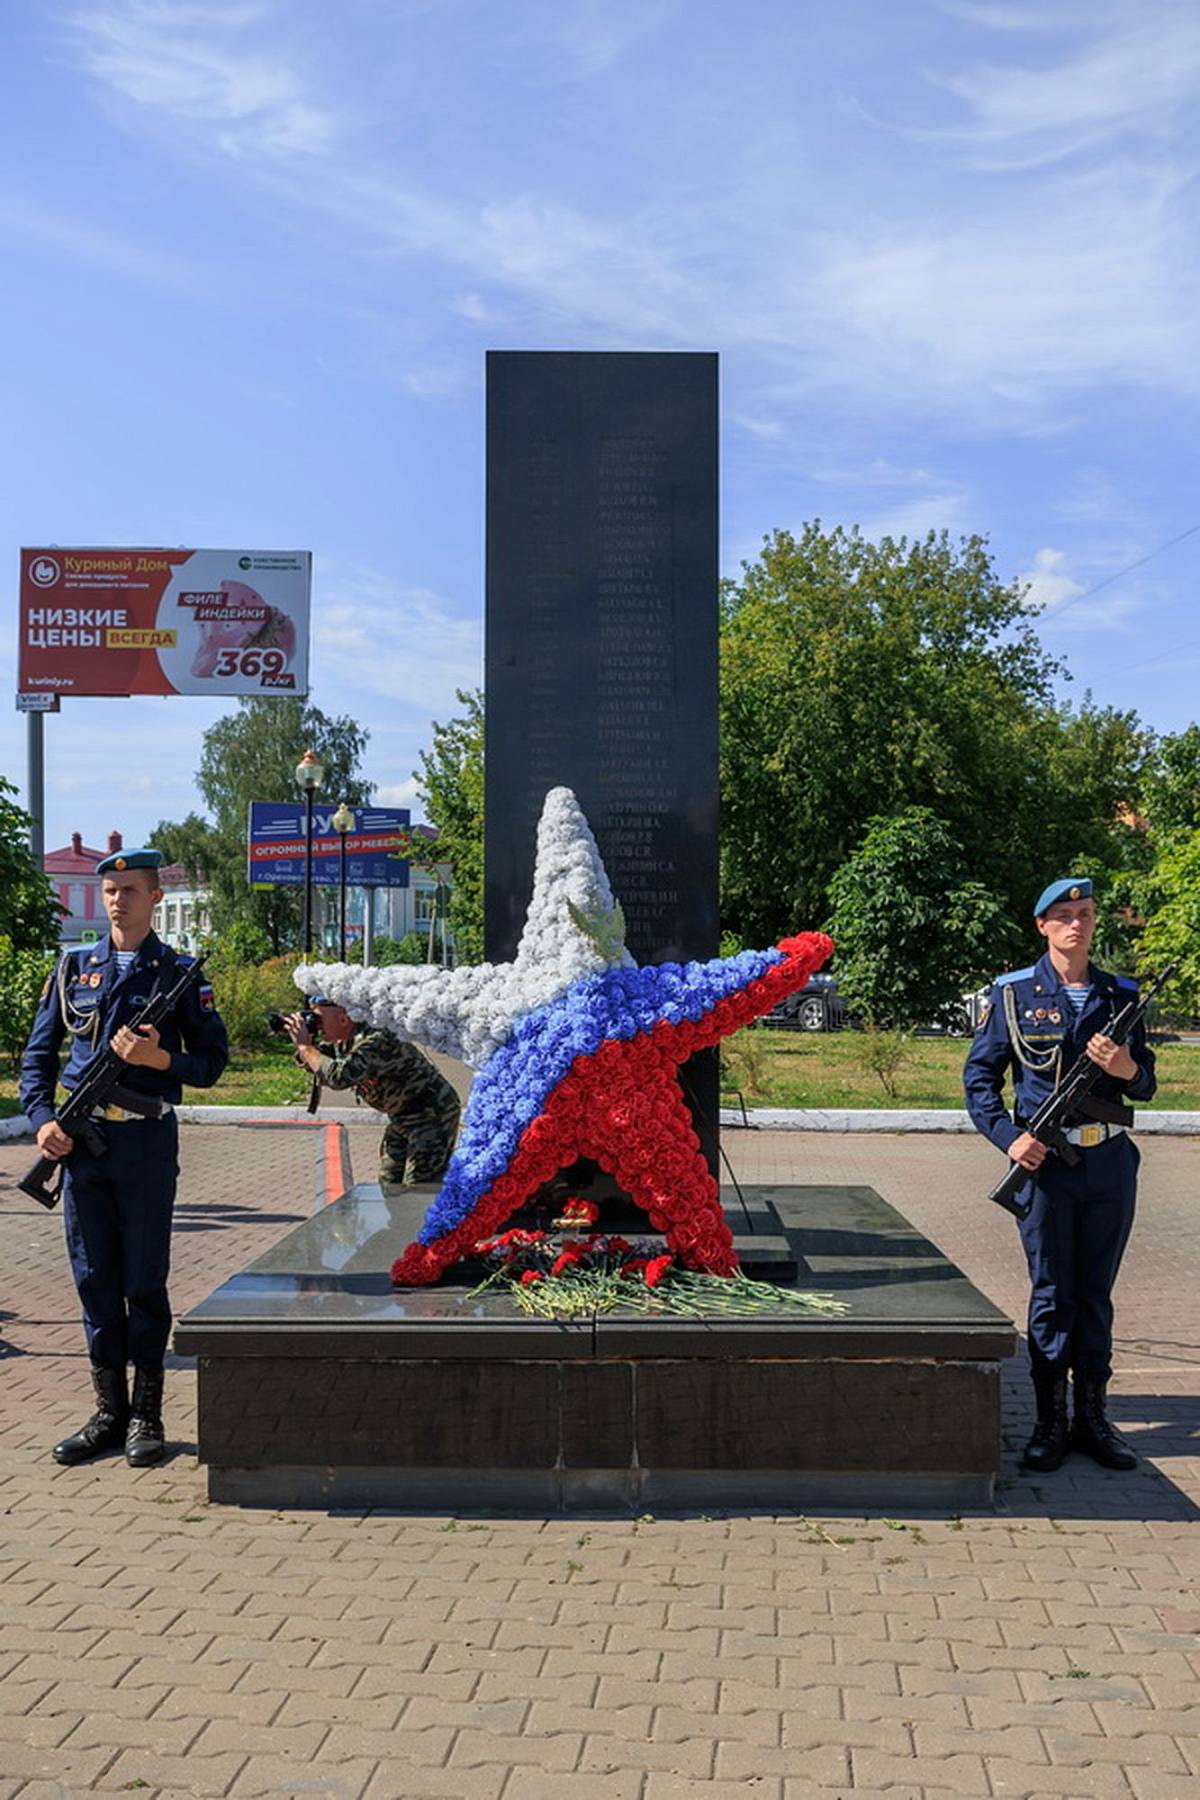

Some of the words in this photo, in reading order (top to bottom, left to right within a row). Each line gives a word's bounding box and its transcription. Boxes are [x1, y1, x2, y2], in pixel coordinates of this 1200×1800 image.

[64, 557, 133, 573] Куриный
[135, 558, 169, 573] Дом
[183, 593, 224, 605] ФИЛЕ
[28, 608, 128, 628] НИЗКИЕ
[199, 607, 266, 620] ИНДЕЙКИ
[28, 629, 101, 649] ЦЕНЫ
[109, 631, 175, 646] ВСЕГДА
[216, 651, 285, 677] 369
